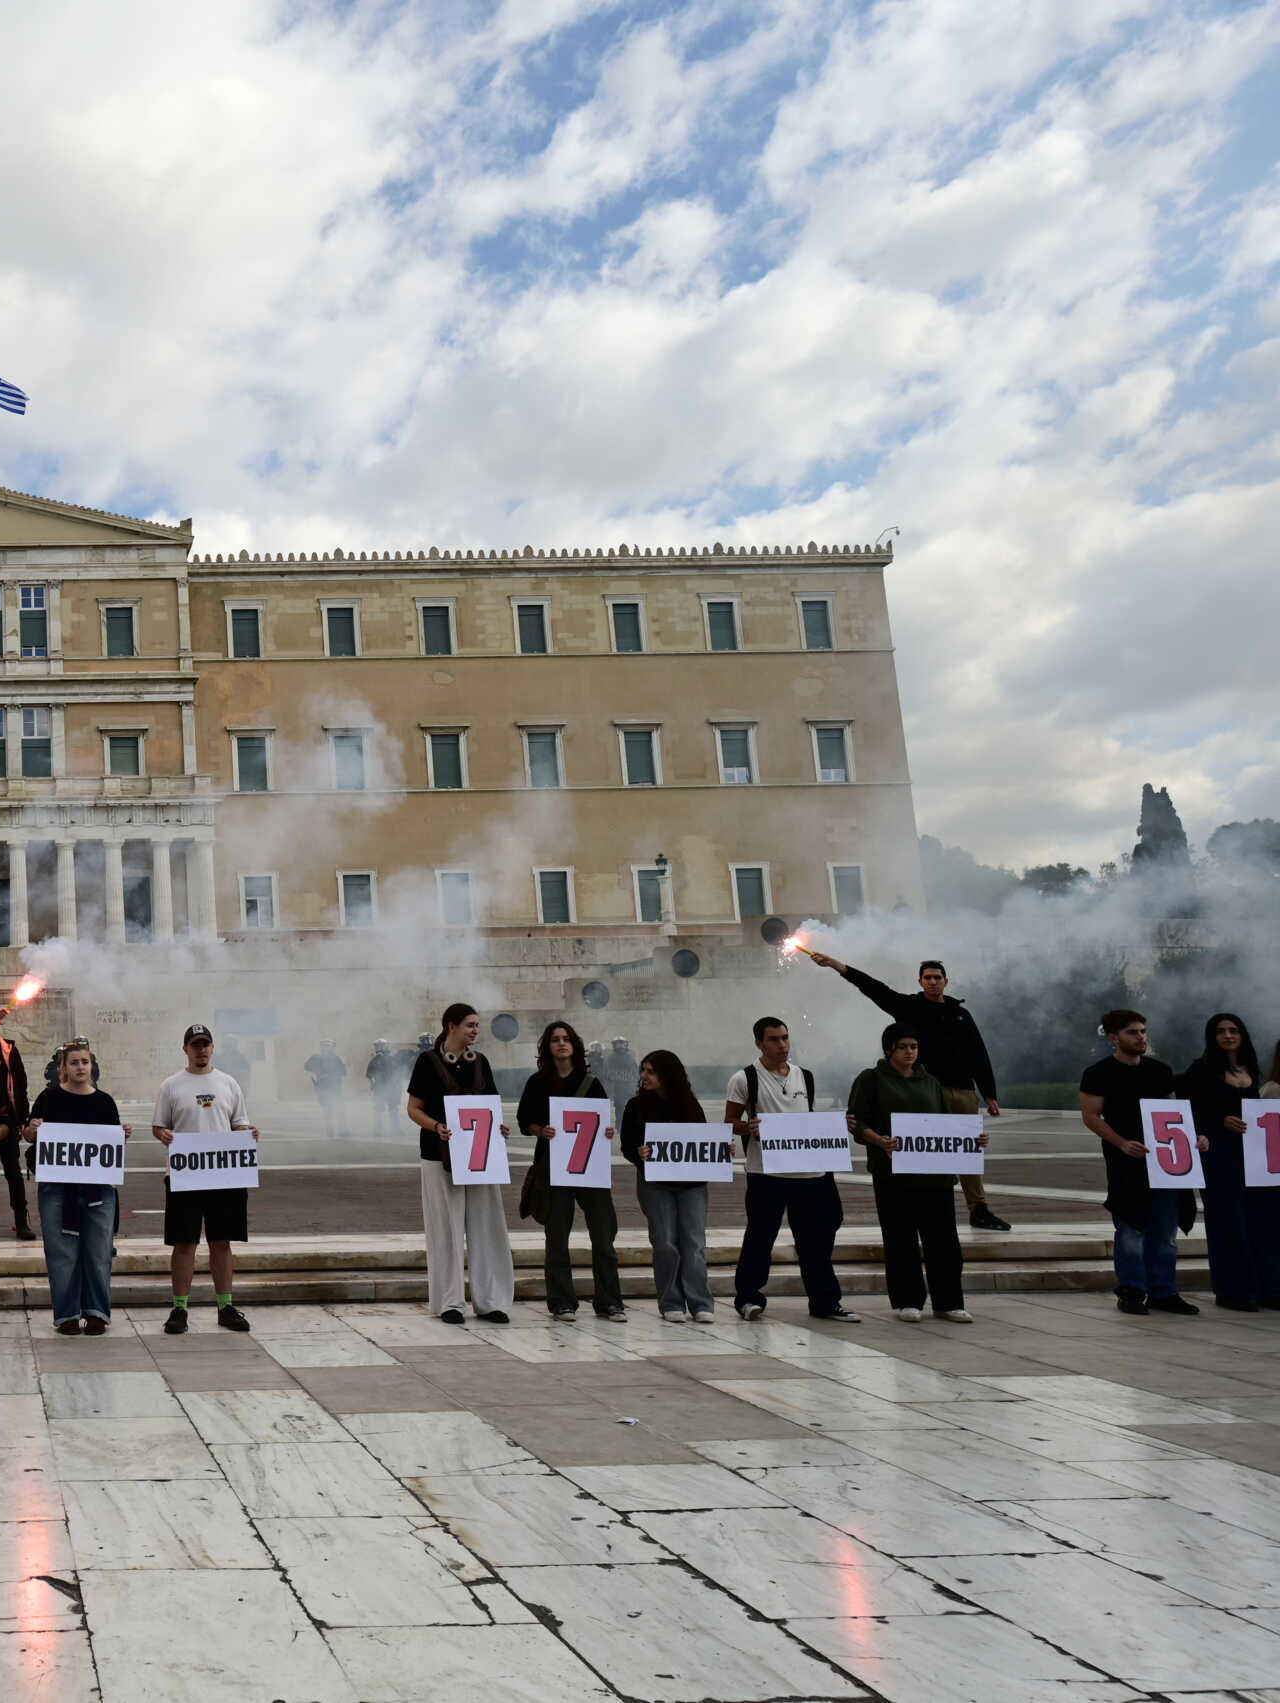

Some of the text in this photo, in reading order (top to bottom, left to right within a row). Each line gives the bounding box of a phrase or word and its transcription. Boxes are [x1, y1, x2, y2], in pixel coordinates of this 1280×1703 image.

[38, 1141, 123, 1168] ΝΕΚΡΟΙ
[170, 1149, 258, 1171] ΦΟΙΤΗΤΕΣ
[458, 1108, 493, 1172] 7
[562, 1110, 600, 1174] 7
[646, 1141, 731, 1163] ΣΧΟΛΕΙΑ
[762, 1137, 849, 1151] ΚΑΤΑΣΤΡΑΦΗΚΑΝ
[1150, 1111, 1193, 1176] 5
[1256, 1112, 1280, 1174] 1
